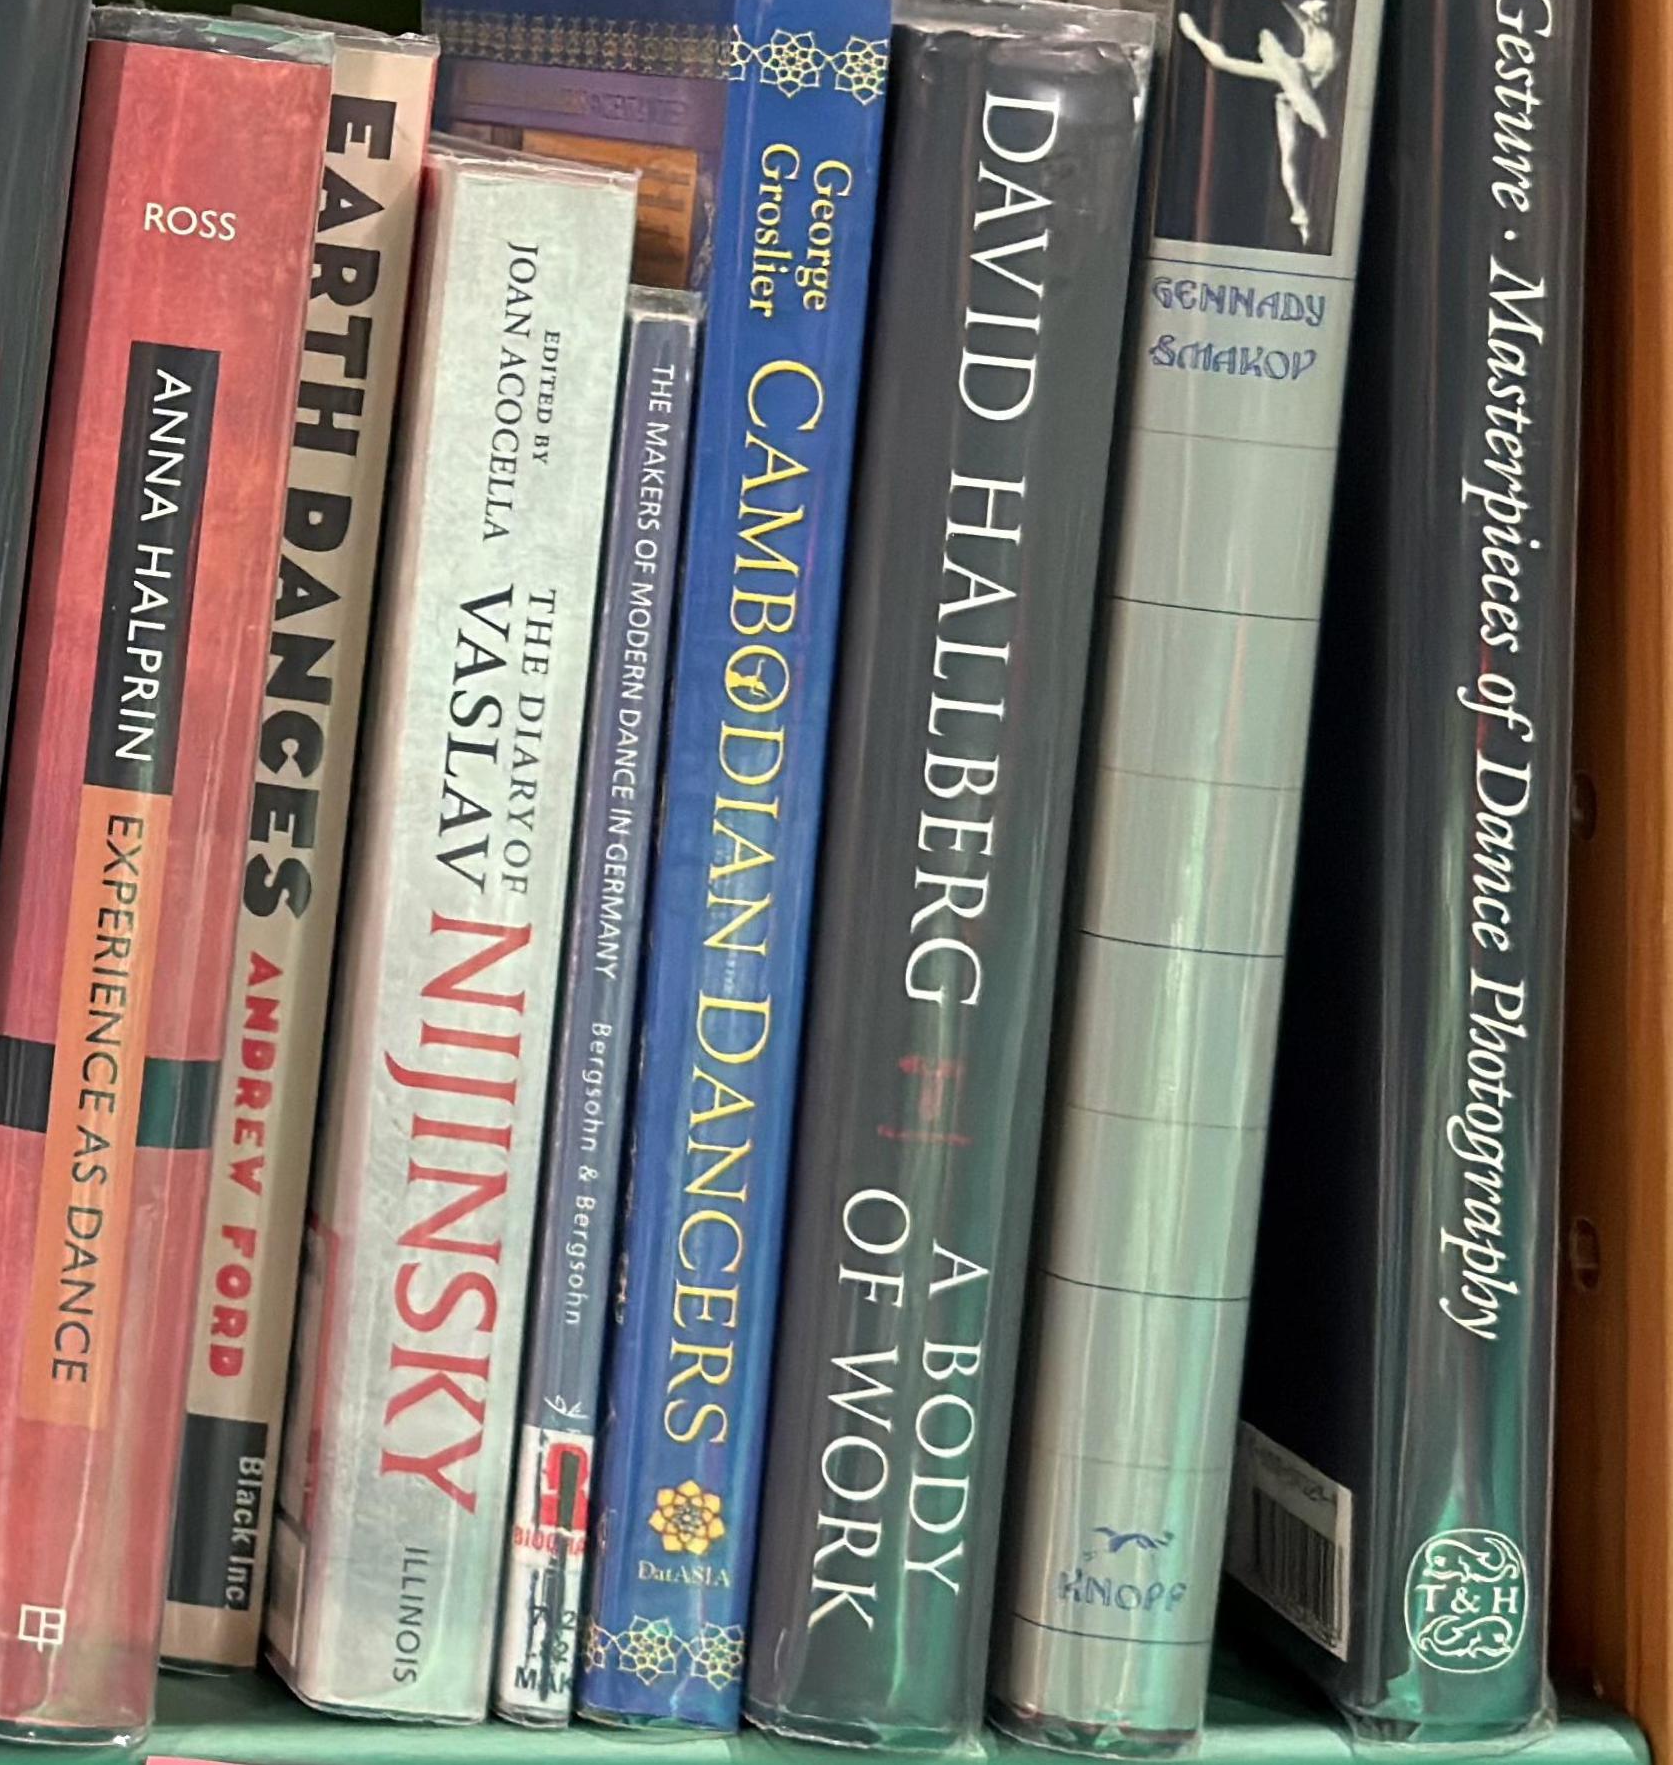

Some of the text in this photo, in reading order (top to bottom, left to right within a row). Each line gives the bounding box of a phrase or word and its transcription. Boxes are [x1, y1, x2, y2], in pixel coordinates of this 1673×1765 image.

[143, 202, 237, 242] ROSS
[748, 144, 801, 318] Groslier
[794, 158, 853, 311] George
[1149, 335, 1317, 380] SMAKOV
[1152, 277, 1325, 327] GENNADY
[482, 242, 539, 542] JOAN ACOCELLA
[537, 331, 561, 424] EDITED
[1461, 255, 1547, 654] Masterpieces
[115, 368, 192, 763] ANNA HALPRIN
[593, 363, 676, 980] THE MAKERS MODERN DANCE GERMANY
[905, 90, 1060, 1007] DAVID HALLBERG
[207, 94, 398, 1378] EARTH DANCES ANDREW FORD
[435, 583, 514, 895] VASLAV
[500, 589, 557, 896] THE DIARY OF
[1457, 673, 1534, 743] of
[1471, 749, 1531, 952] Dance
[663, 359, 825, 1444] CAMBODIAN DANCERS
[50, 813, 145, 1385] EXPERIENCE AS DANCE
[379, 911, 532, 1514] NIJINSKY
[565, 1022, 612, 1325] Bergsohn Bergsohn
[1439, 976, 1528, 1341] Photography
[231, 1456, 265, 1543] Black
[807, 1188, 911, 1631] OF WORK
[904, 1239, 989, 1596] A BODY
[392, 1546, 429, 1685] ILLINOIS
